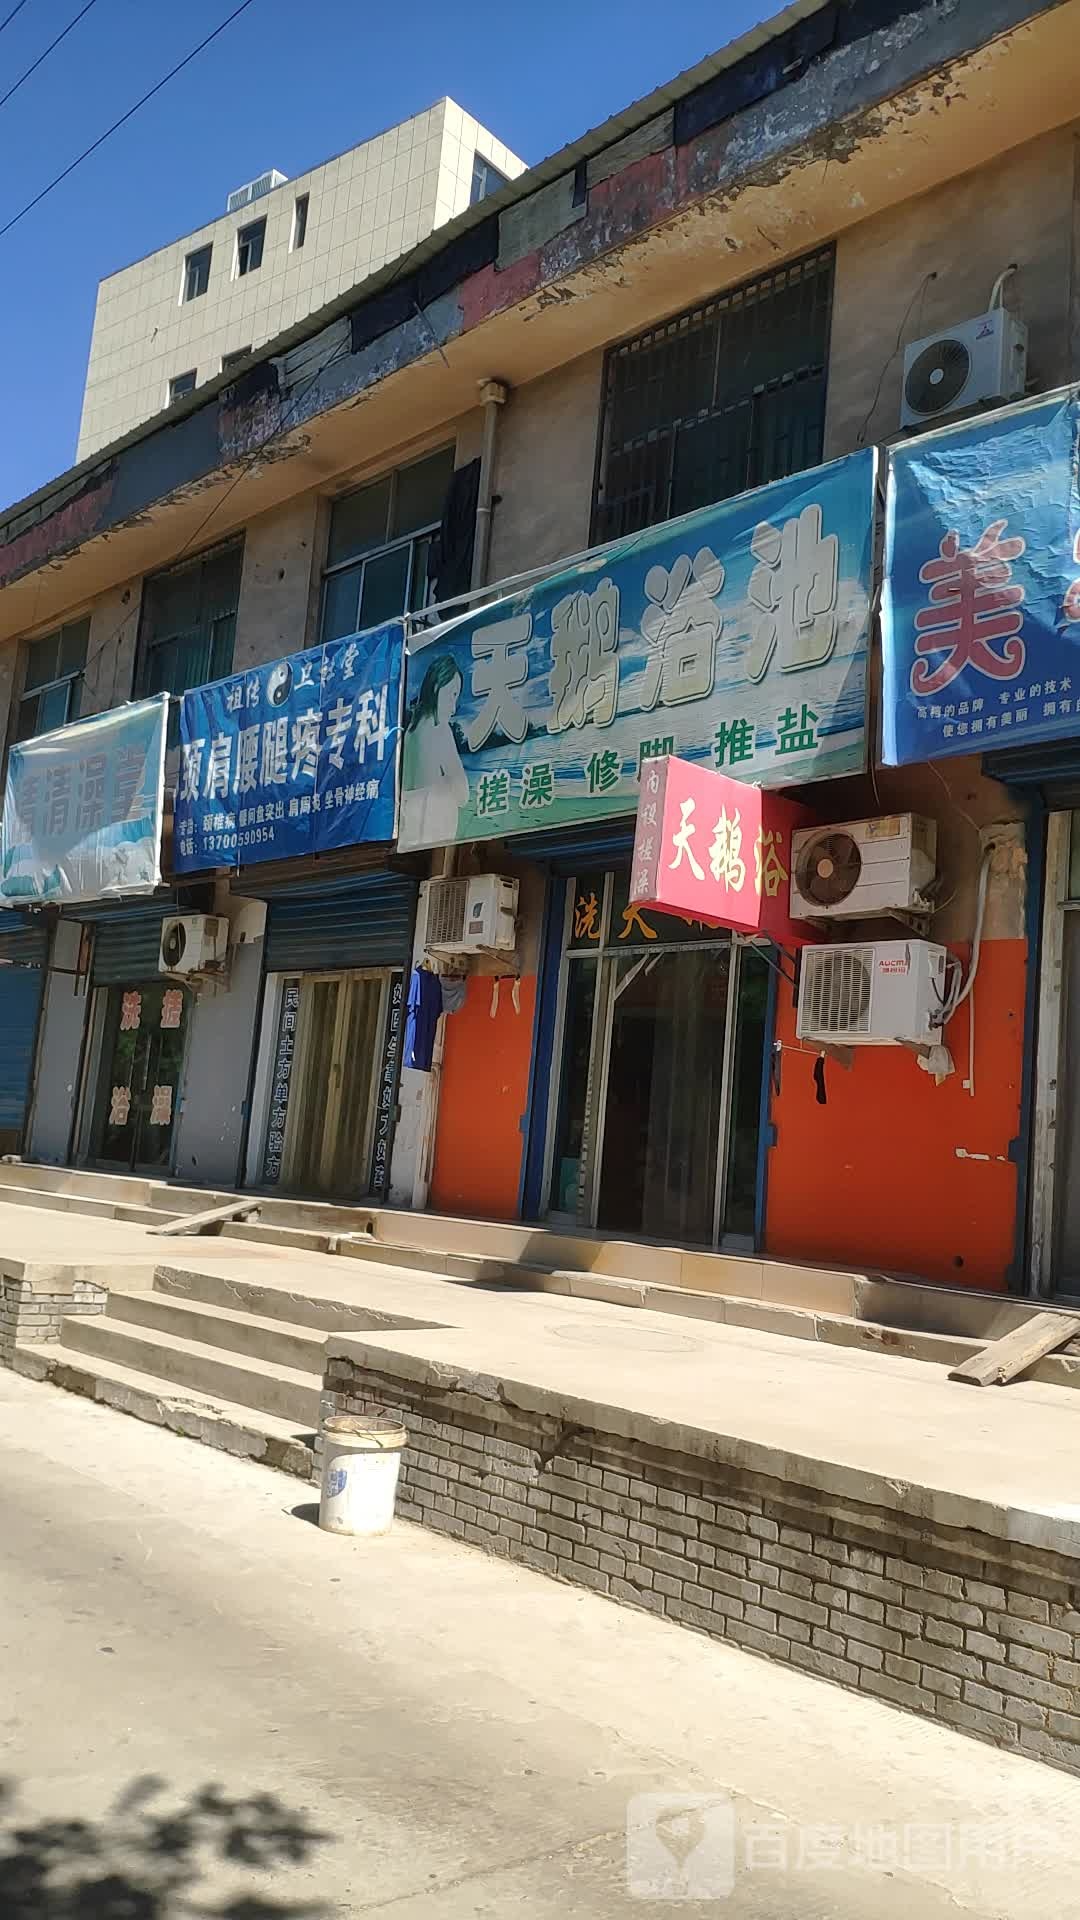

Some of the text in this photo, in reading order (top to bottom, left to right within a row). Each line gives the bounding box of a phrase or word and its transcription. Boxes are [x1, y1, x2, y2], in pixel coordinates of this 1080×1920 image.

[467, 503, 840, 753] 天鹅浴池
[910, 518, 1080, 697] 美
[226, 680, 261, 713] 祖传
[942, 707, 1029, 738] 使您拥有美丽
[998, 677, 1072, 705] 专业的技术
[180, 684, 389, 801] 颈肩腰腿疼专科
[479, 766, 554, 815] 搓澡
[715, 704, 820, 767] 推盐
[203, 812, 236, 833] 颈椎病
[239, 800, 285, 828] 腰间盘突出
[289, 794, 322, 817] 肩周炎
[324, 779, 379, 810] 坐骨神经痛
[203, 826, 275, 851] 13700590954
[668, 797, 789, 896] 天鹅浴
[574, 891, 602, 940] 洗
[266, 986, 299, 1178] 民间土方单方验方
